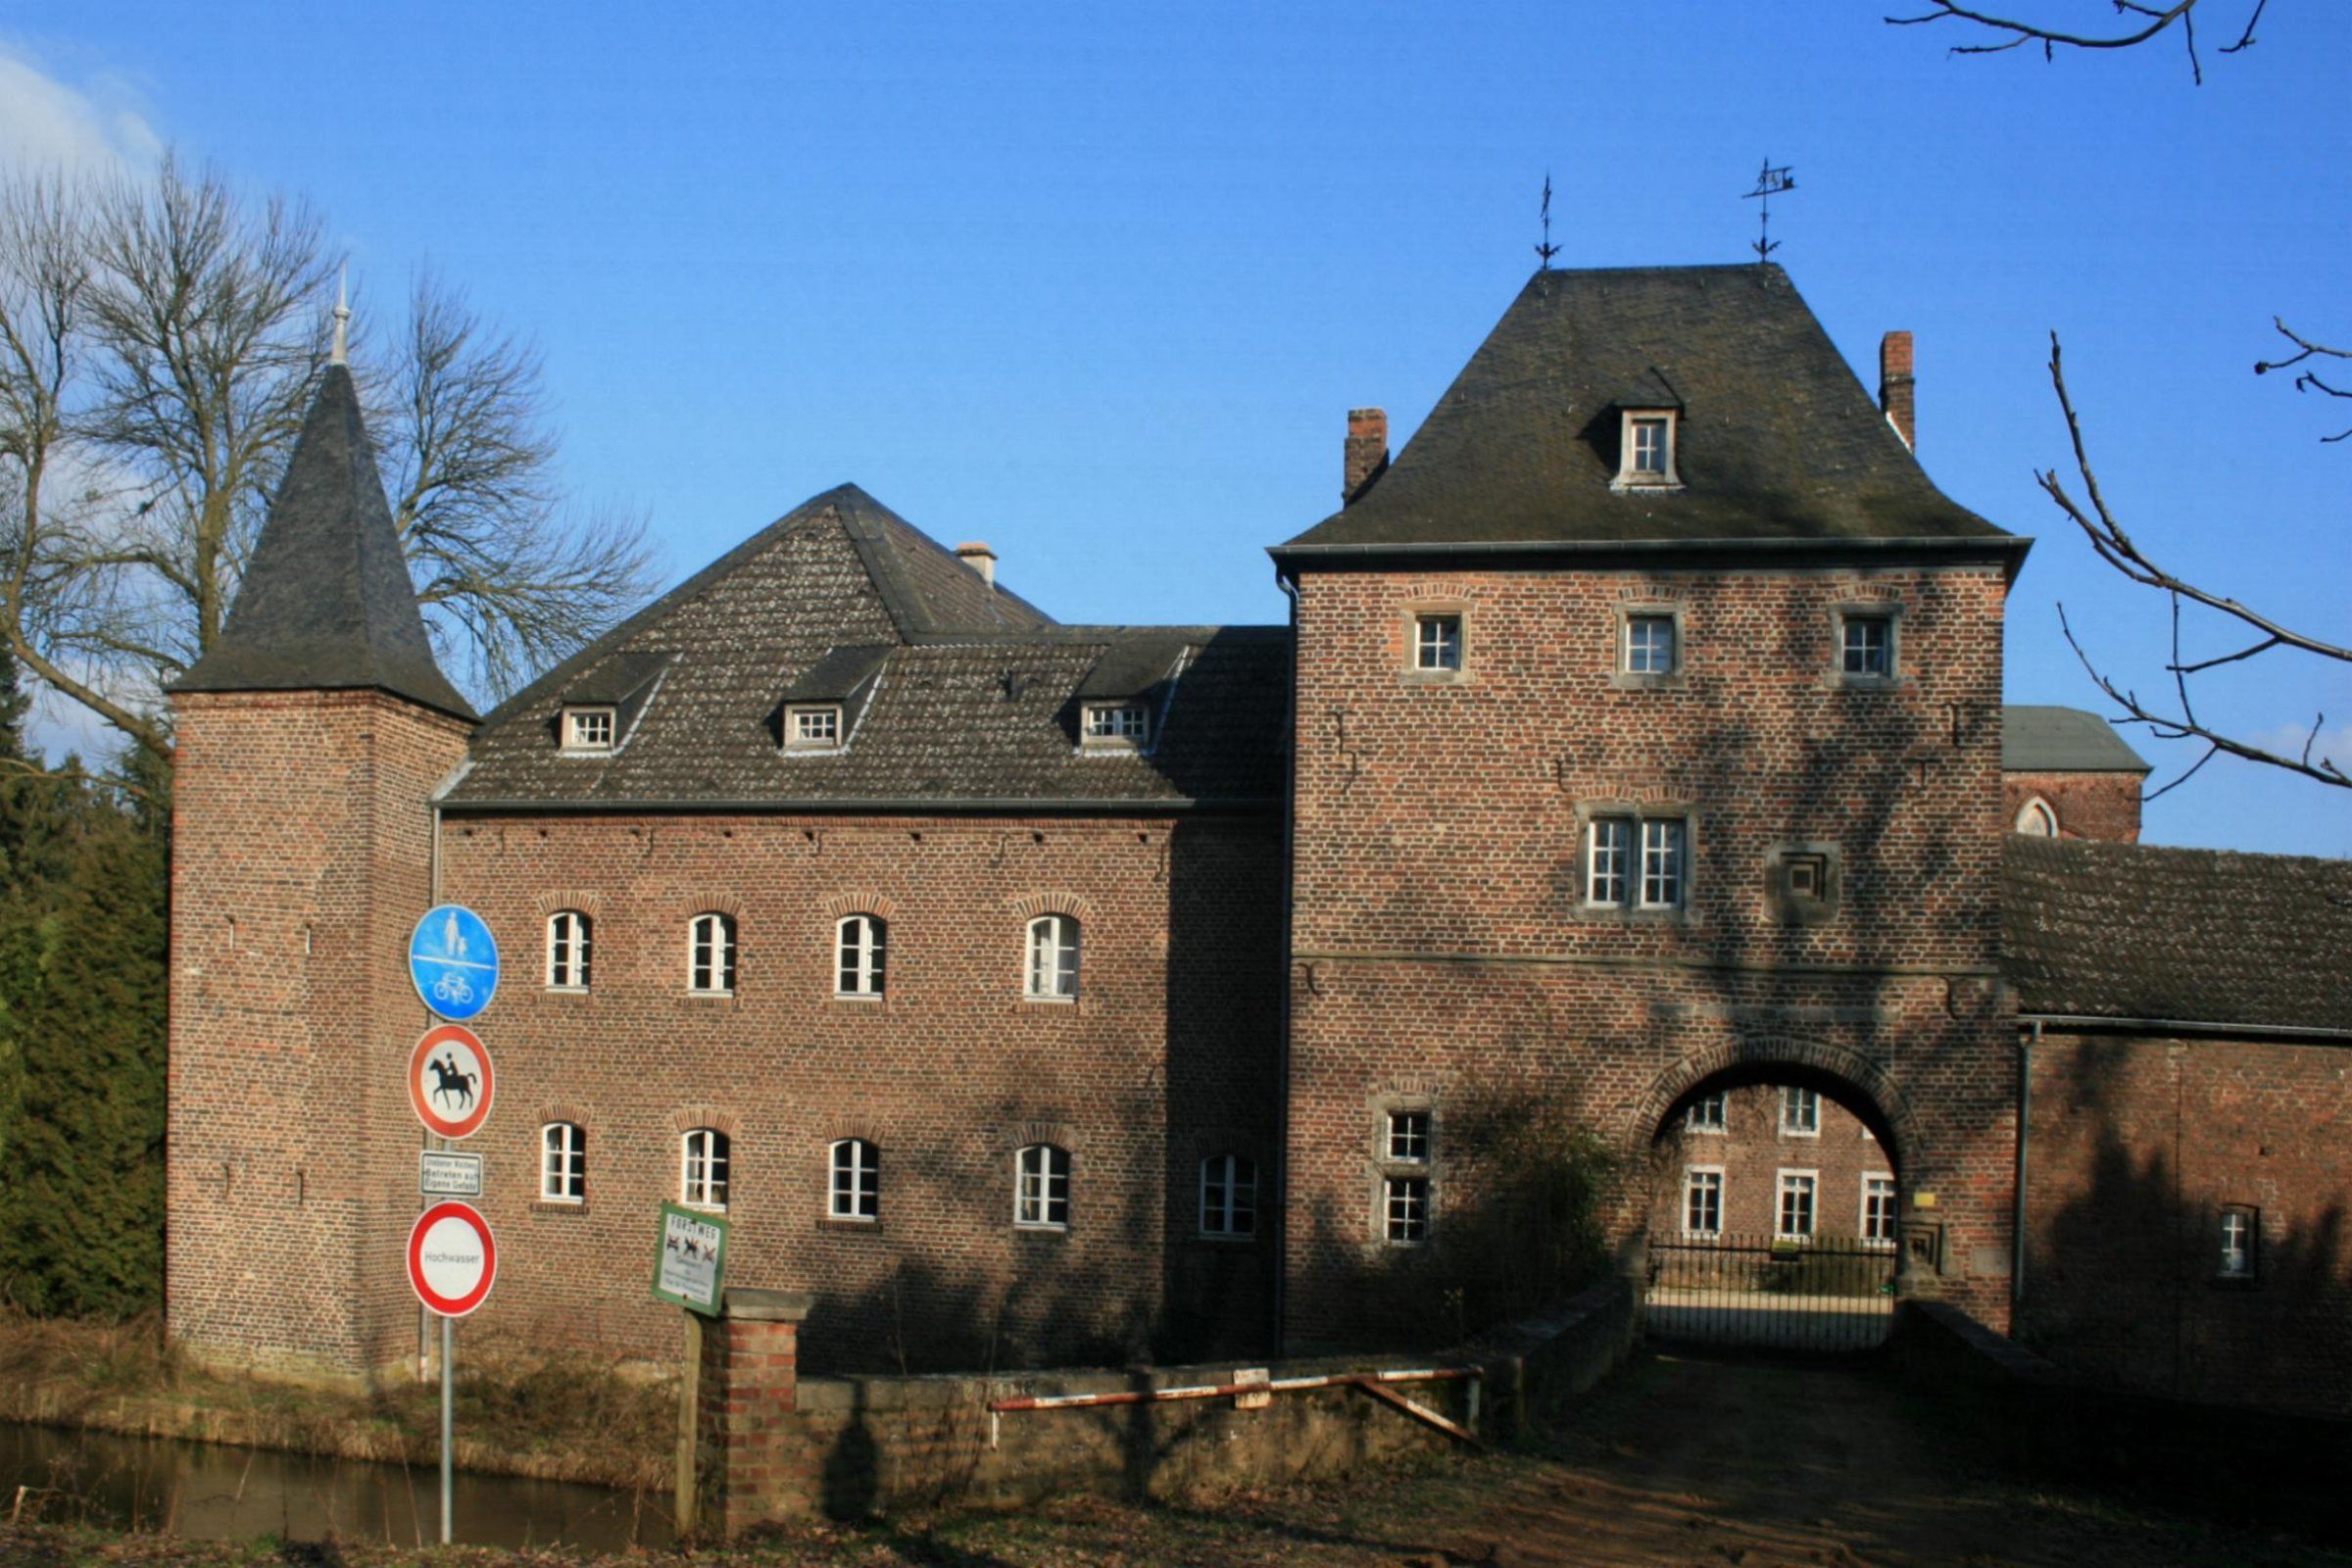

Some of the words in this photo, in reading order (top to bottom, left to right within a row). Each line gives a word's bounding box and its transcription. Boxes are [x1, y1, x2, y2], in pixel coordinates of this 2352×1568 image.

[425, 1168, 462, 1179] Betreten
[453, 1179, 476, 1192] Gefahr
[670, 1215, 716, 1240] FORSTWEG
[425, 1250, 479, 1265] Hochwasser
